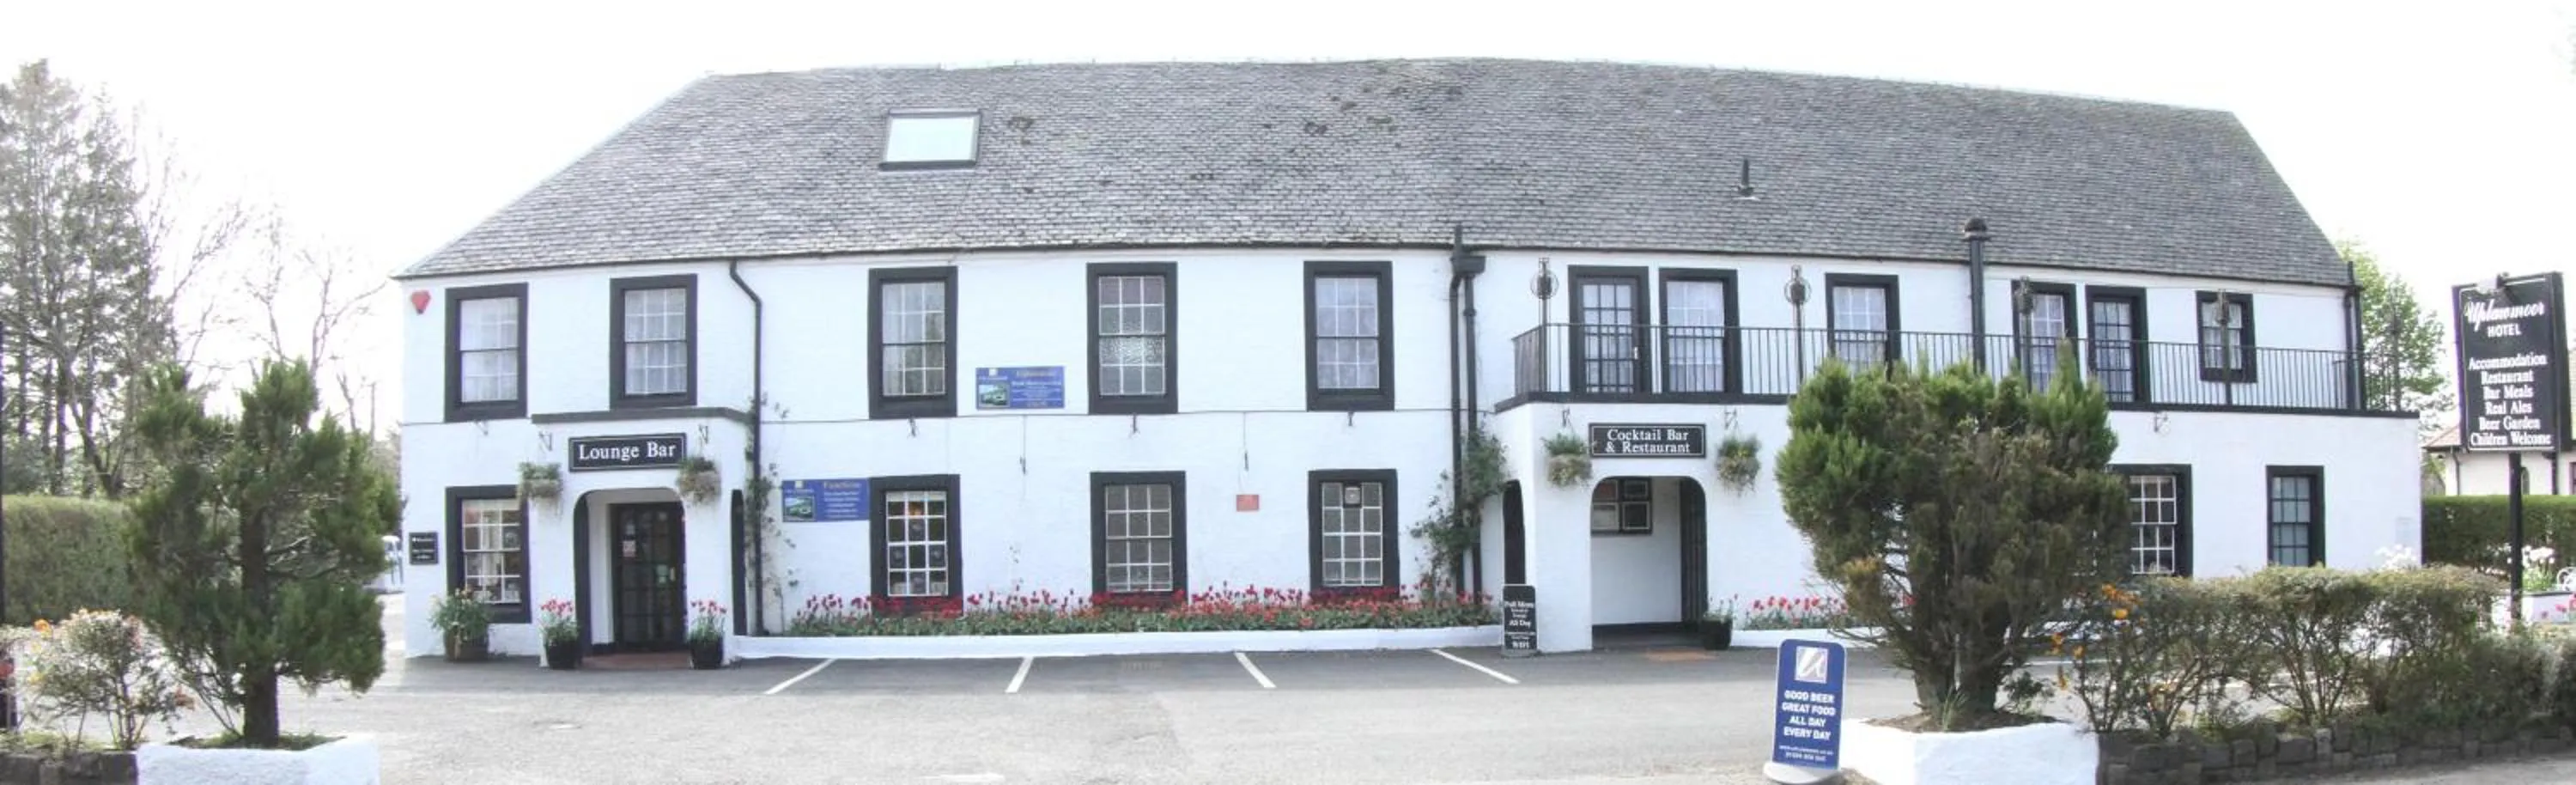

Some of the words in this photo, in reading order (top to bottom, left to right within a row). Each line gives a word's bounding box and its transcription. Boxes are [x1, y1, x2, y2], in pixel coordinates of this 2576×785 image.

[2487, 323, 2522, 338] HOTEL
[2469, 351, 2548, 371] Accommodation
[2480, 369, 2534, 385] Restaurant
[2482, 386, 2500, 399] Bar
[2503, 384, 2534, 399] Meals
[2485, 401, 2506, 415] Real
[2510, 399, 2532, 414] Ales
[2478, 417, 2500, 431] Beer
[2503, 415, 2541, 430] Garden
[1607, 429, 1662, 441] Cocktail
[1667, 429, 1689, 441] Bar
[2470, 432, 2508, 447] Children
[2510, 430, 2552, 446] Welcome
[579, 444, 640, 461] Lounge
[646, 441, 676, 458] Bar
[1606, 441, 1615, 453] &
[1622, 441, 1691, 453] Restaurant
[1784, 690, 1808, 701] GOOD
[1810, 692, 1834, 703] BEER
[1782, 702, 1810, 713] GREAT
[1812, 705, 1836, 716] FOOD
[1789, 715, 1807, 725] ALL
[1808, 717, 1826, 727] DAY
[1783, 727, 1812, 738] EVERY
[1813, 730, 1831, 740] DAY
